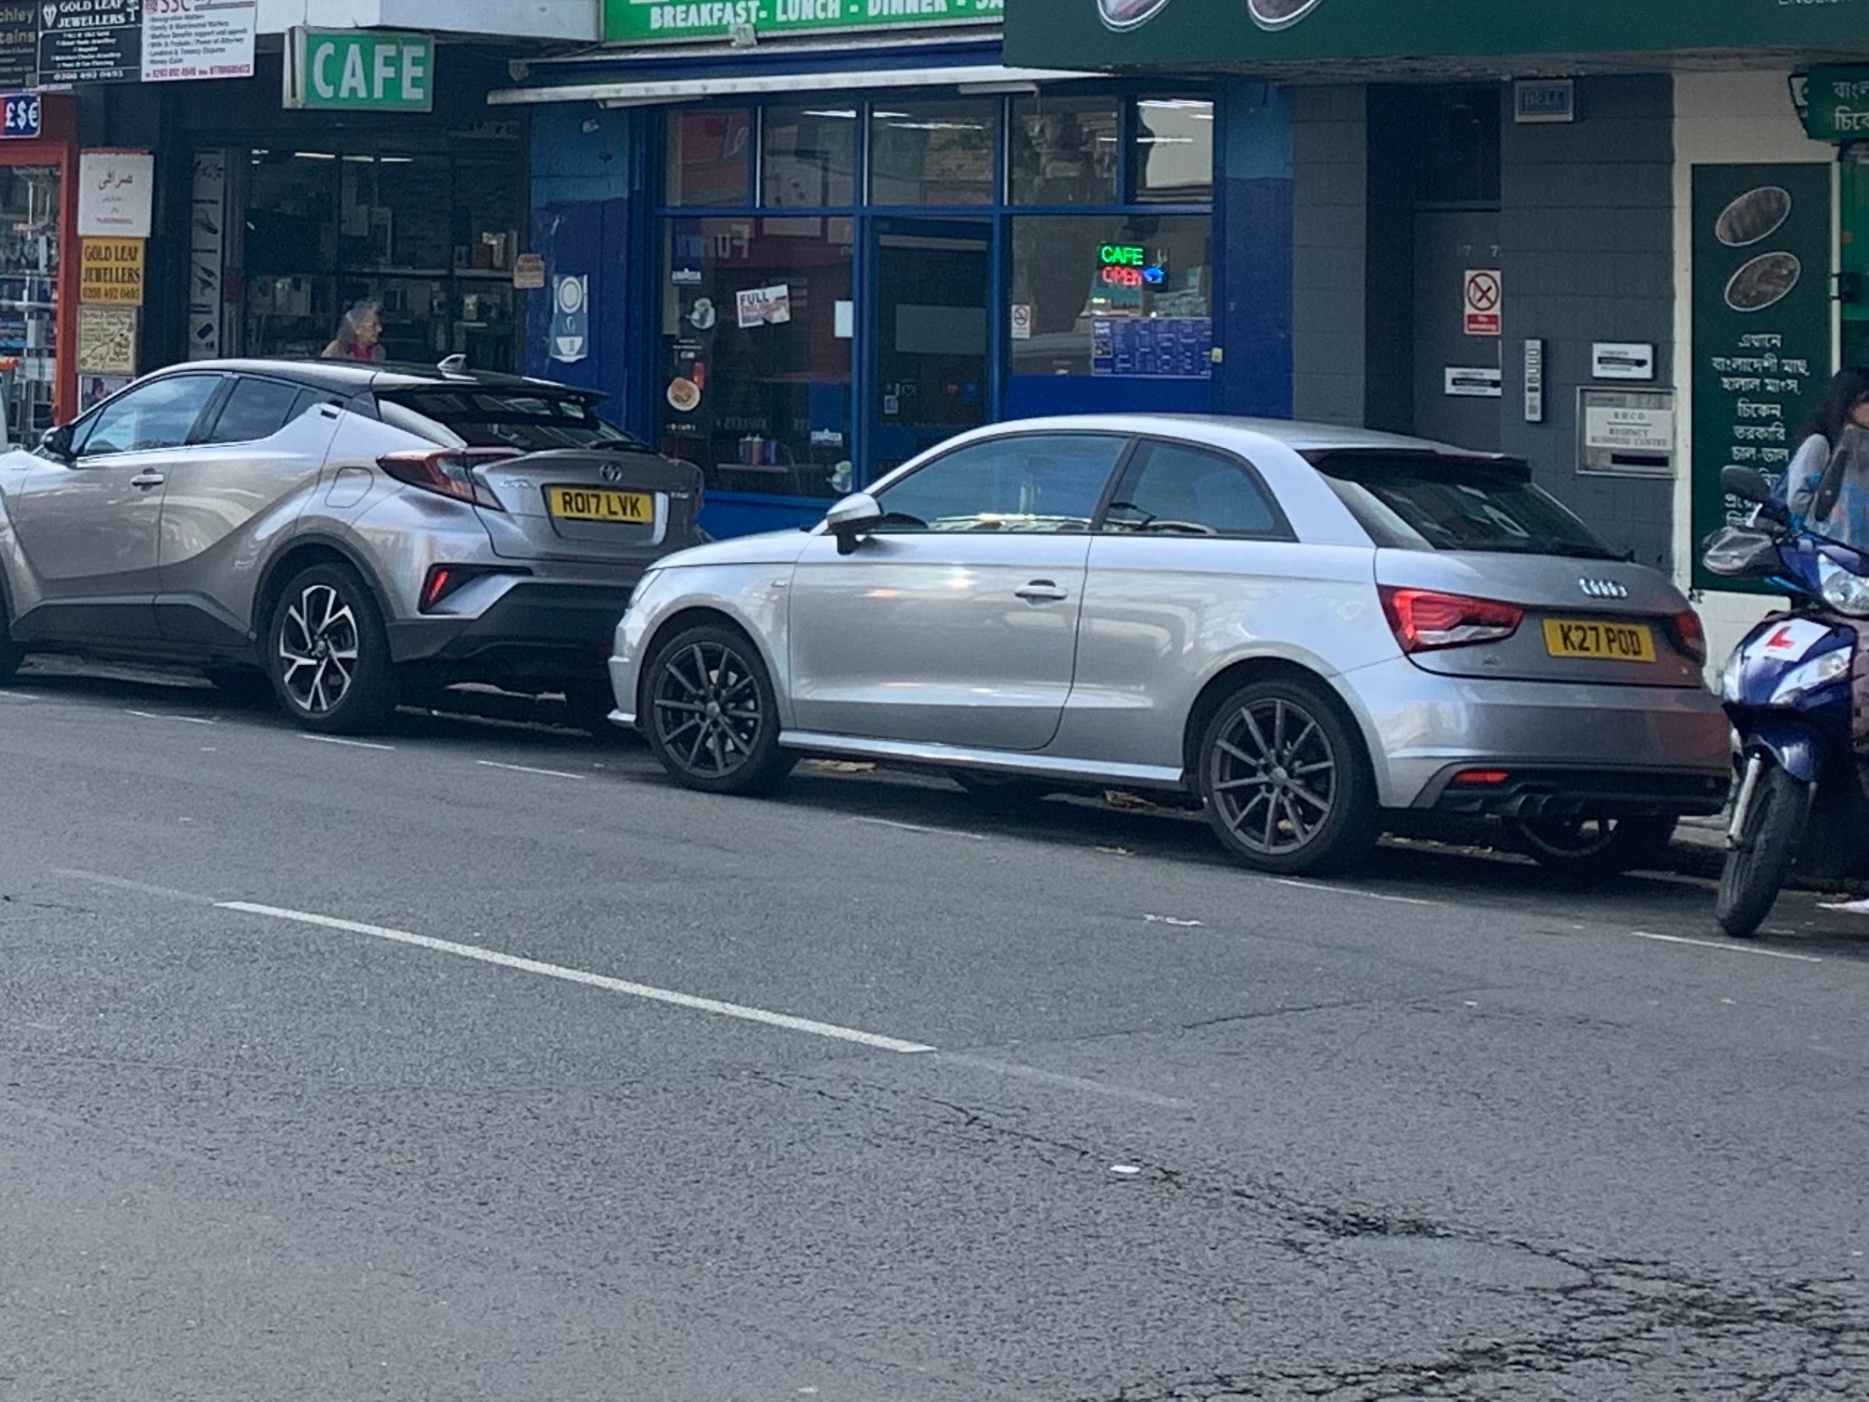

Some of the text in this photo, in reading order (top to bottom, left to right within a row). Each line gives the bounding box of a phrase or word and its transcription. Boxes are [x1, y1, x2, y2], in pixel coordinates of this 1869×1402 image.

[59, 0, 91, 13] GOLD
[57, 13, 126, 28] JEWELLERS
[313, 42, 426, 100] CAFE
[84, 245, 139, 261] GOLD LEAF
[1101, 245, 1144, 266] CAFE
[82, 267, 141, 283] JEWELLERS
[1102, 266, 1143, 286] OPEN
[740, 291, 770, 306] FULL
[562, 491, 642, 517] RO17 LVK
[1560, 624, 1642, 656] K27 POD
[1764, 627, 1795, 649] L
